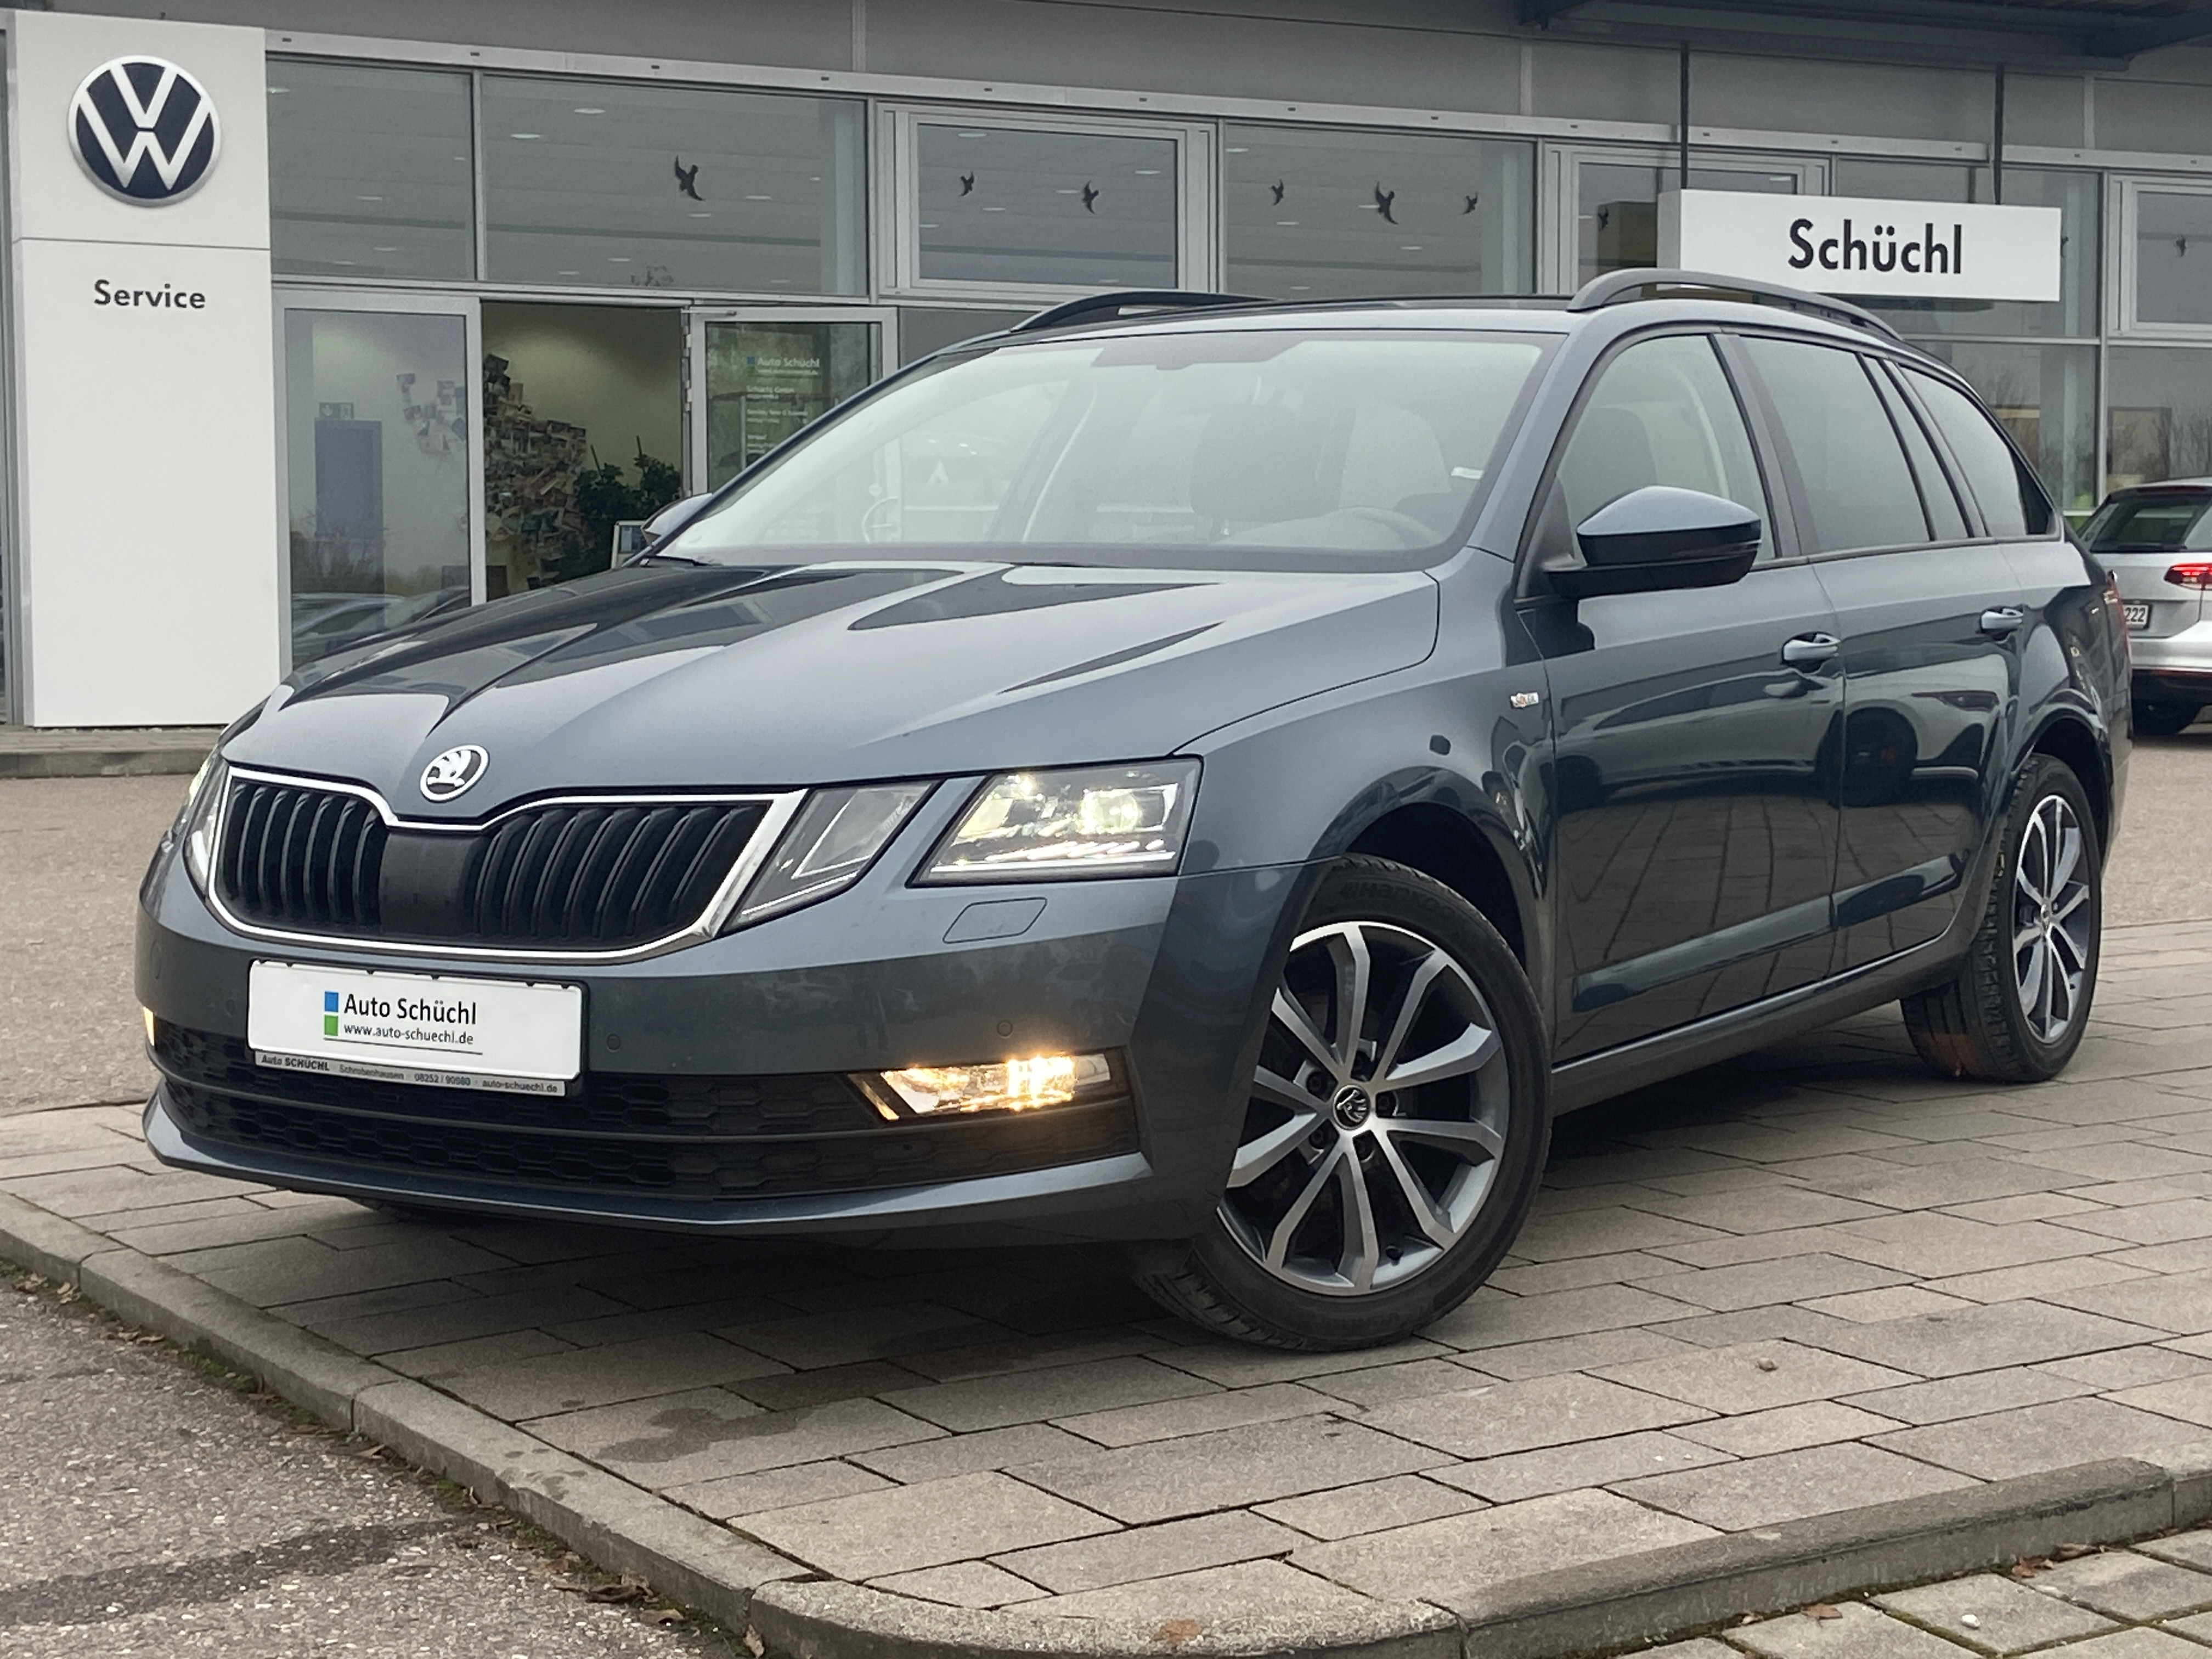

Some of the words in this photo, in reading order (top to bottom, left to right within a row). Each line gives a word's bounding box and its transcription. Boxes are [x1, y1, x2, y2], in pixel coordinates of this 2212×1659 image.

[1788, 218, 1962, 274] Schüchl
[94, 279, 206, 309] Service
[758, 357, 781, 366] Auto
[344, 994, 390, 1017] Auto
[397, 997, 476, 1025] Schüchl
[344, 1024, 474, 1045] www.auto-schuechl.de
[261, 1054, 282, 1065] Auto
[482, 1080, 557, 1093] auto-schuechl.de
